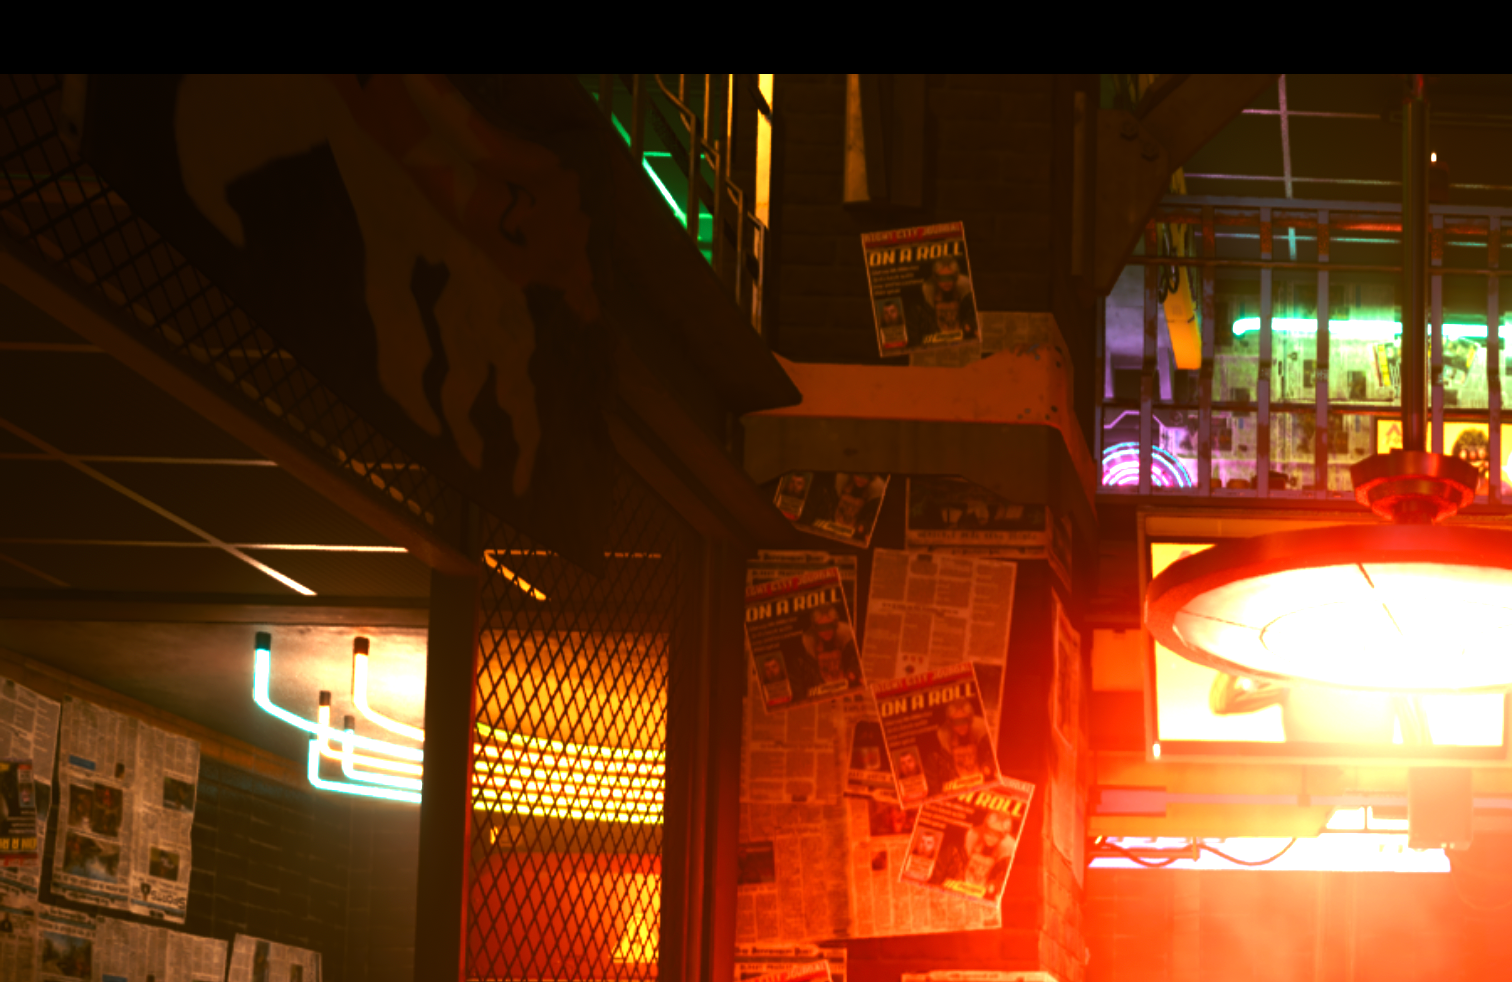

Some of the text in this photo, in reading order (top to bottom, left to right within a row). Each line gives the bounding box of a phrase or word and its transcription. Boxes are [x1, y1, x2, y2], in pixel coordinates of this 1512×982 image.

[868, 240, 964, 267] ON A ROLL
[745, 588, 842, 622] ON A ROLL
[881, 682, 976, 718] ON A ROLL
[974, 791, 1022, 818] ROLL
